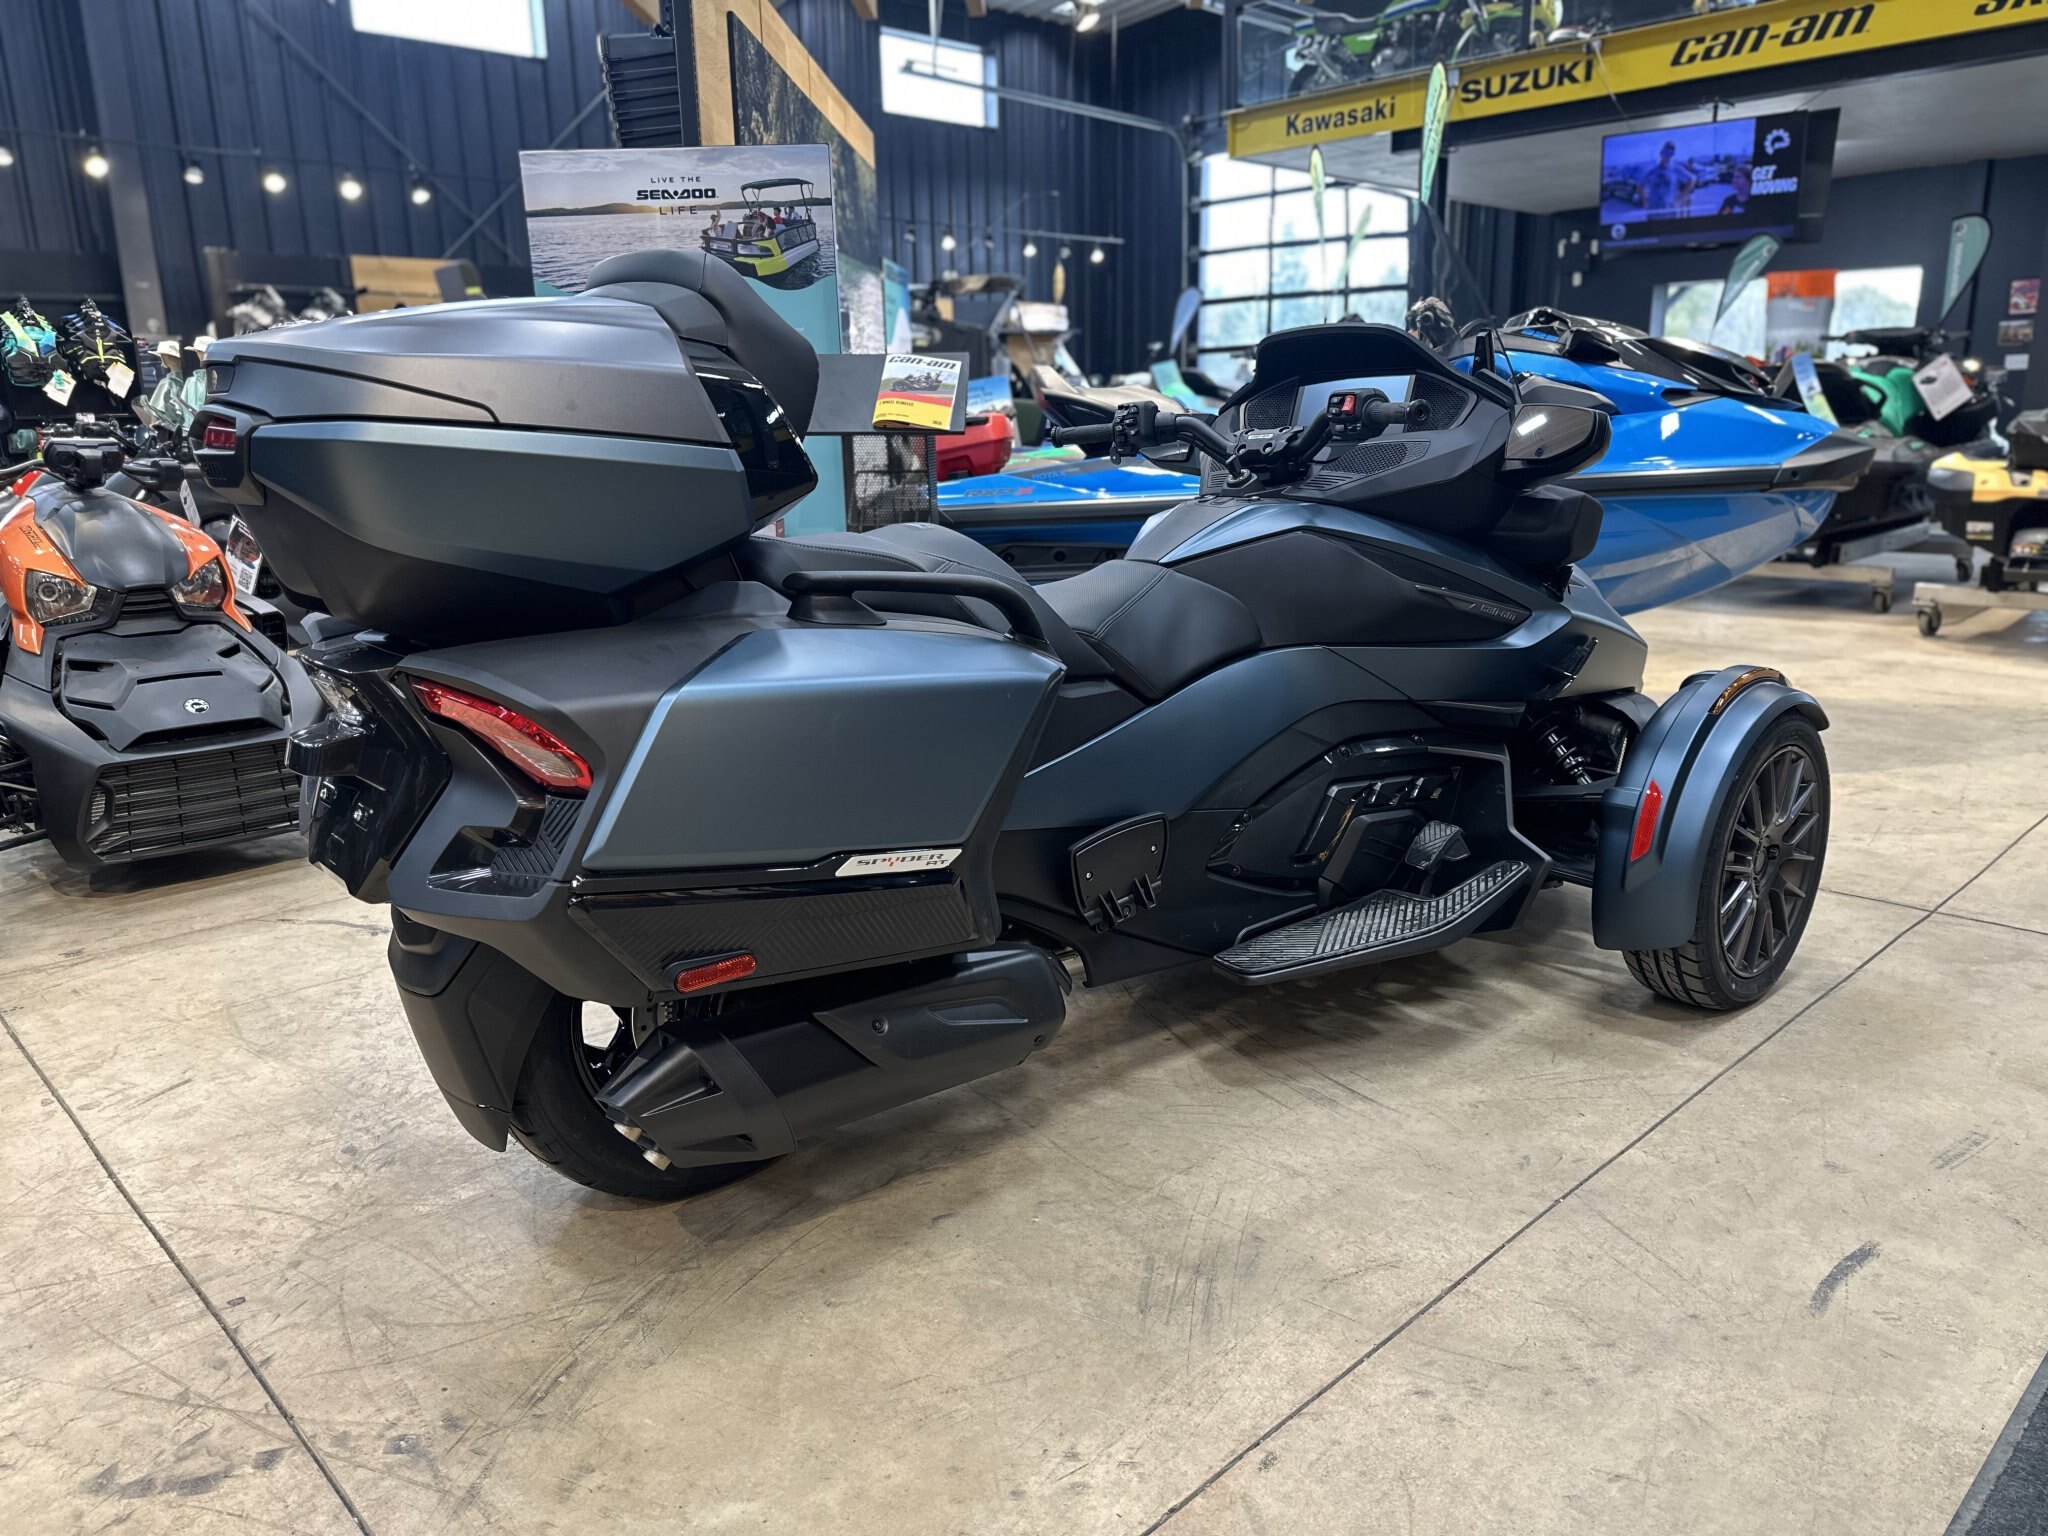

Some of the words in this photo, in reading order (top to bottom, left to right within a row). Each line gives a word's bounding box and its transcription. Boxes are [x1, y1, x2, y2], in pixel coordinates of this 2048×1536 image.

[1669, 2, 1876, 68] can-am
[1460, 58, 1594, 104] SUZUKI
[1286, 95, 1396, 137] Kawasaki
[1752, 165, 1777, 181] GET
[1751, 177, 1798, 196] MOVING
[658, 205, 698, 216] LIFE
[888, 355, 957, 370] can-am
[857, 853, 944, 867] SPYDER
